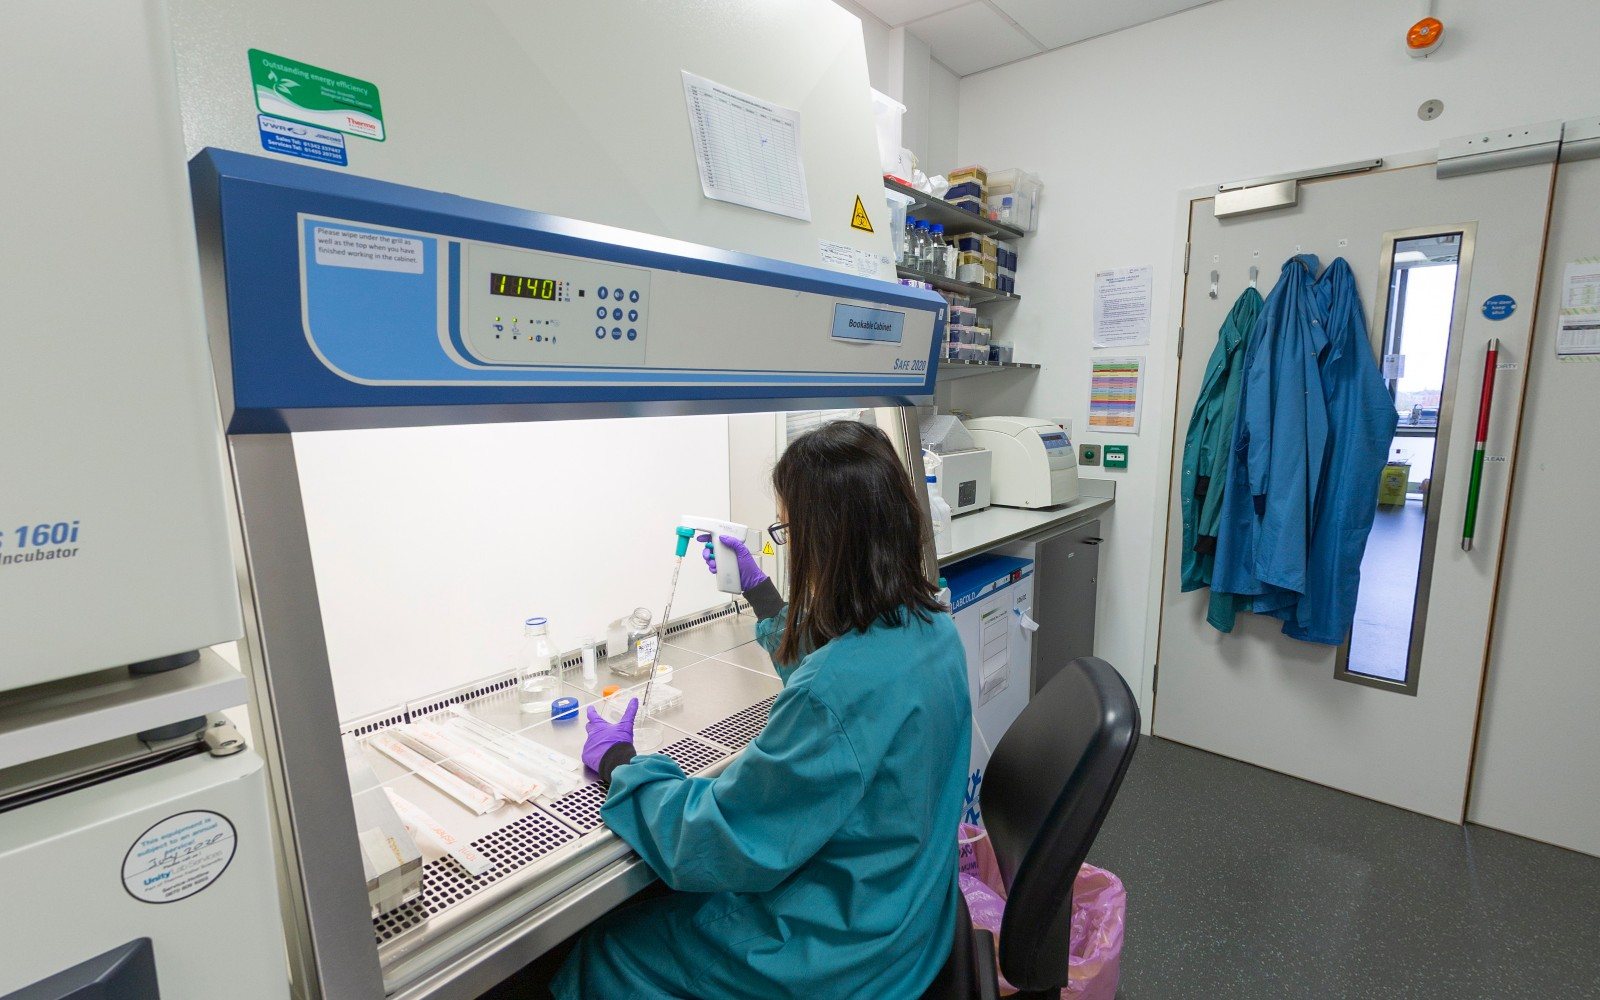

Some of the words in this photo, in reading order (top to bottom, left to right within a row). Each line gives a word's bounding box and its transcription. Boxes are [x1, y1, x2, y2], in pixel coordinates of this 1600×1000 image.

[262, 59, 310, 80] Outstanding
[311, 73, 335, 87] energy
[336, 80, 369, 96] efficiency
[346, 116, 376, 130] Thermo
[317, 228, 340, 236] Please
[341, 231, 358, 239] wipe
[391, 236, 403, 244] grill
[318, 247, 346, 256] finished
[347, 250, 373, 260] working
[369, 243, 386, 251] when
[848, 319, 873, 330] Bookable
[874, 322, 892, 332] Cabinet
[894, 358, 910, 370] SAFE
[910, 360, 926, 371] 2020
[14, 520, 80, 548] 160i
[952, 592, 976, 610] LABCOLD
[143, 870, 172, 886] Unity
